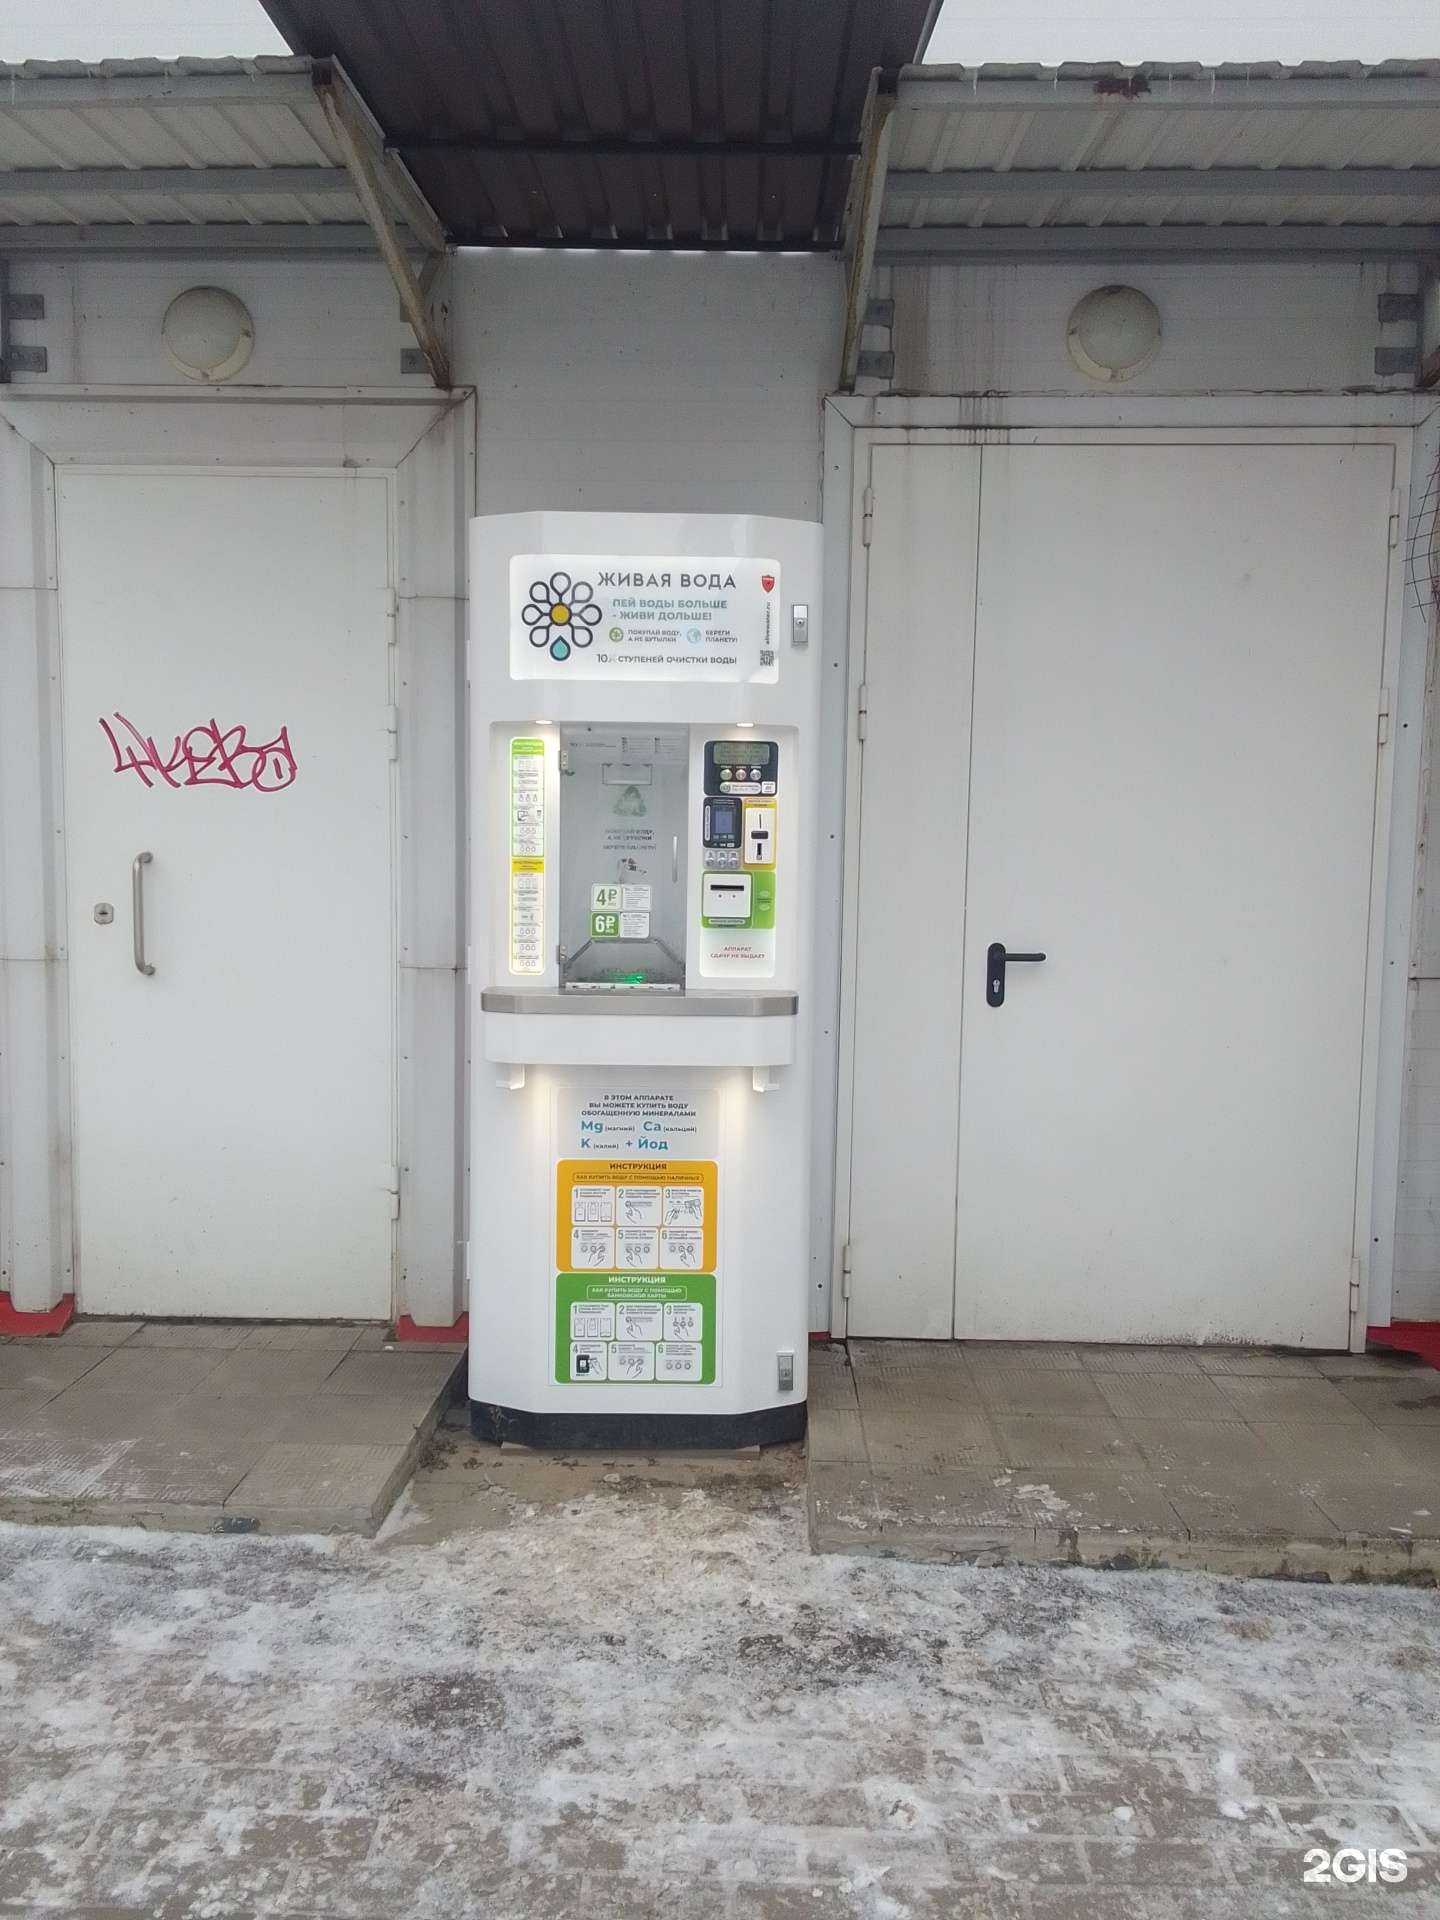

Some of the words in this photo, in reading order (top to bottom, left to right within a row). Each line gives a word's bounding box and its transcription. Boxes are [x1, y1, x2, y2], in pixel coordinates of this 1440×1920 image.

[598, 572, 671, 587] ЖИВАЯ
[680, 574, 736, 590] ВОДА
[612, 598, 636, 608] ПЕЙ
[639, 600, 674, 609] ВОДЫ
[678, 600, 728, 609] БОЛЬШЕ
[619, 611, 655, 621] ЖИВИ
[658, 611, 712, 621] ДОЛЬШЕ!
[618, 655, 664, 663] СТУПЕНЕЙ
[667, 656, 708, 664] ОЧИСТКИ
[710, 657, 737, 665] ВОДЫ
[581, 1121, 603, 1133] Mg
[638, 1136, 668, 1150] Йод
[609, 1163, 667, 1171] ИНСТРУКЦИЯ
[574, 1189, 579, 1198] 1
[618, 1189, 624, 1199] 2
[665, 1189, 671, 1199] 3
[573, 1230, 579, 1239] 4
[618, 1230, 624, 1239] 5
[662, 1230, 667, 1240] 6
[608, 1276, 667, 1284] ИНСТРУКЦИЯ
[573, 1305, 578, 1314] 1
[619, 1305, 625, 1315] 2
[666, 1305, 672, 1315] 3
[573, 1345, 579, 1354] 4
[611, 1345, 617, 1354] 5
[658, 1345, 664, 1354] 6
